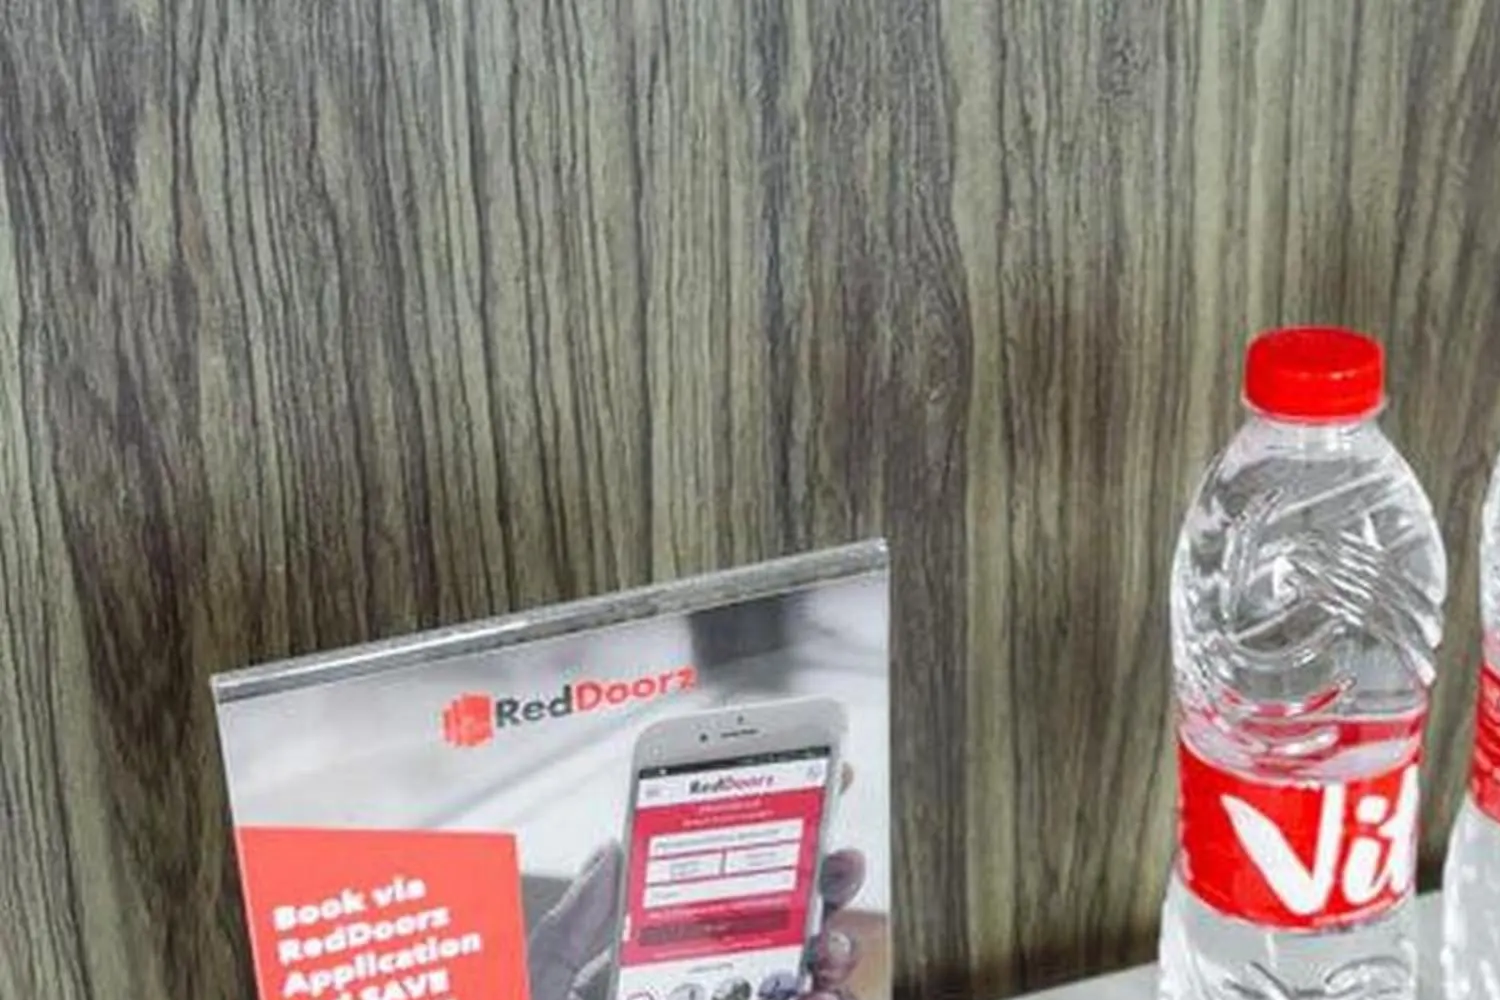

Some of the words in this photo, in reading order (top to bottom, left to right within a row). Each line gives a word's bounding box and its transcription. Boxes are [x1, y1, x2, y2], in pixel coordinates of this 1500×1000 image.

[496, 667, 695, 726] RedDoorz
[274, 889, 364, 929] Book
[372, 876, 424, 905] via
[283, 933, 480, 997] Application
